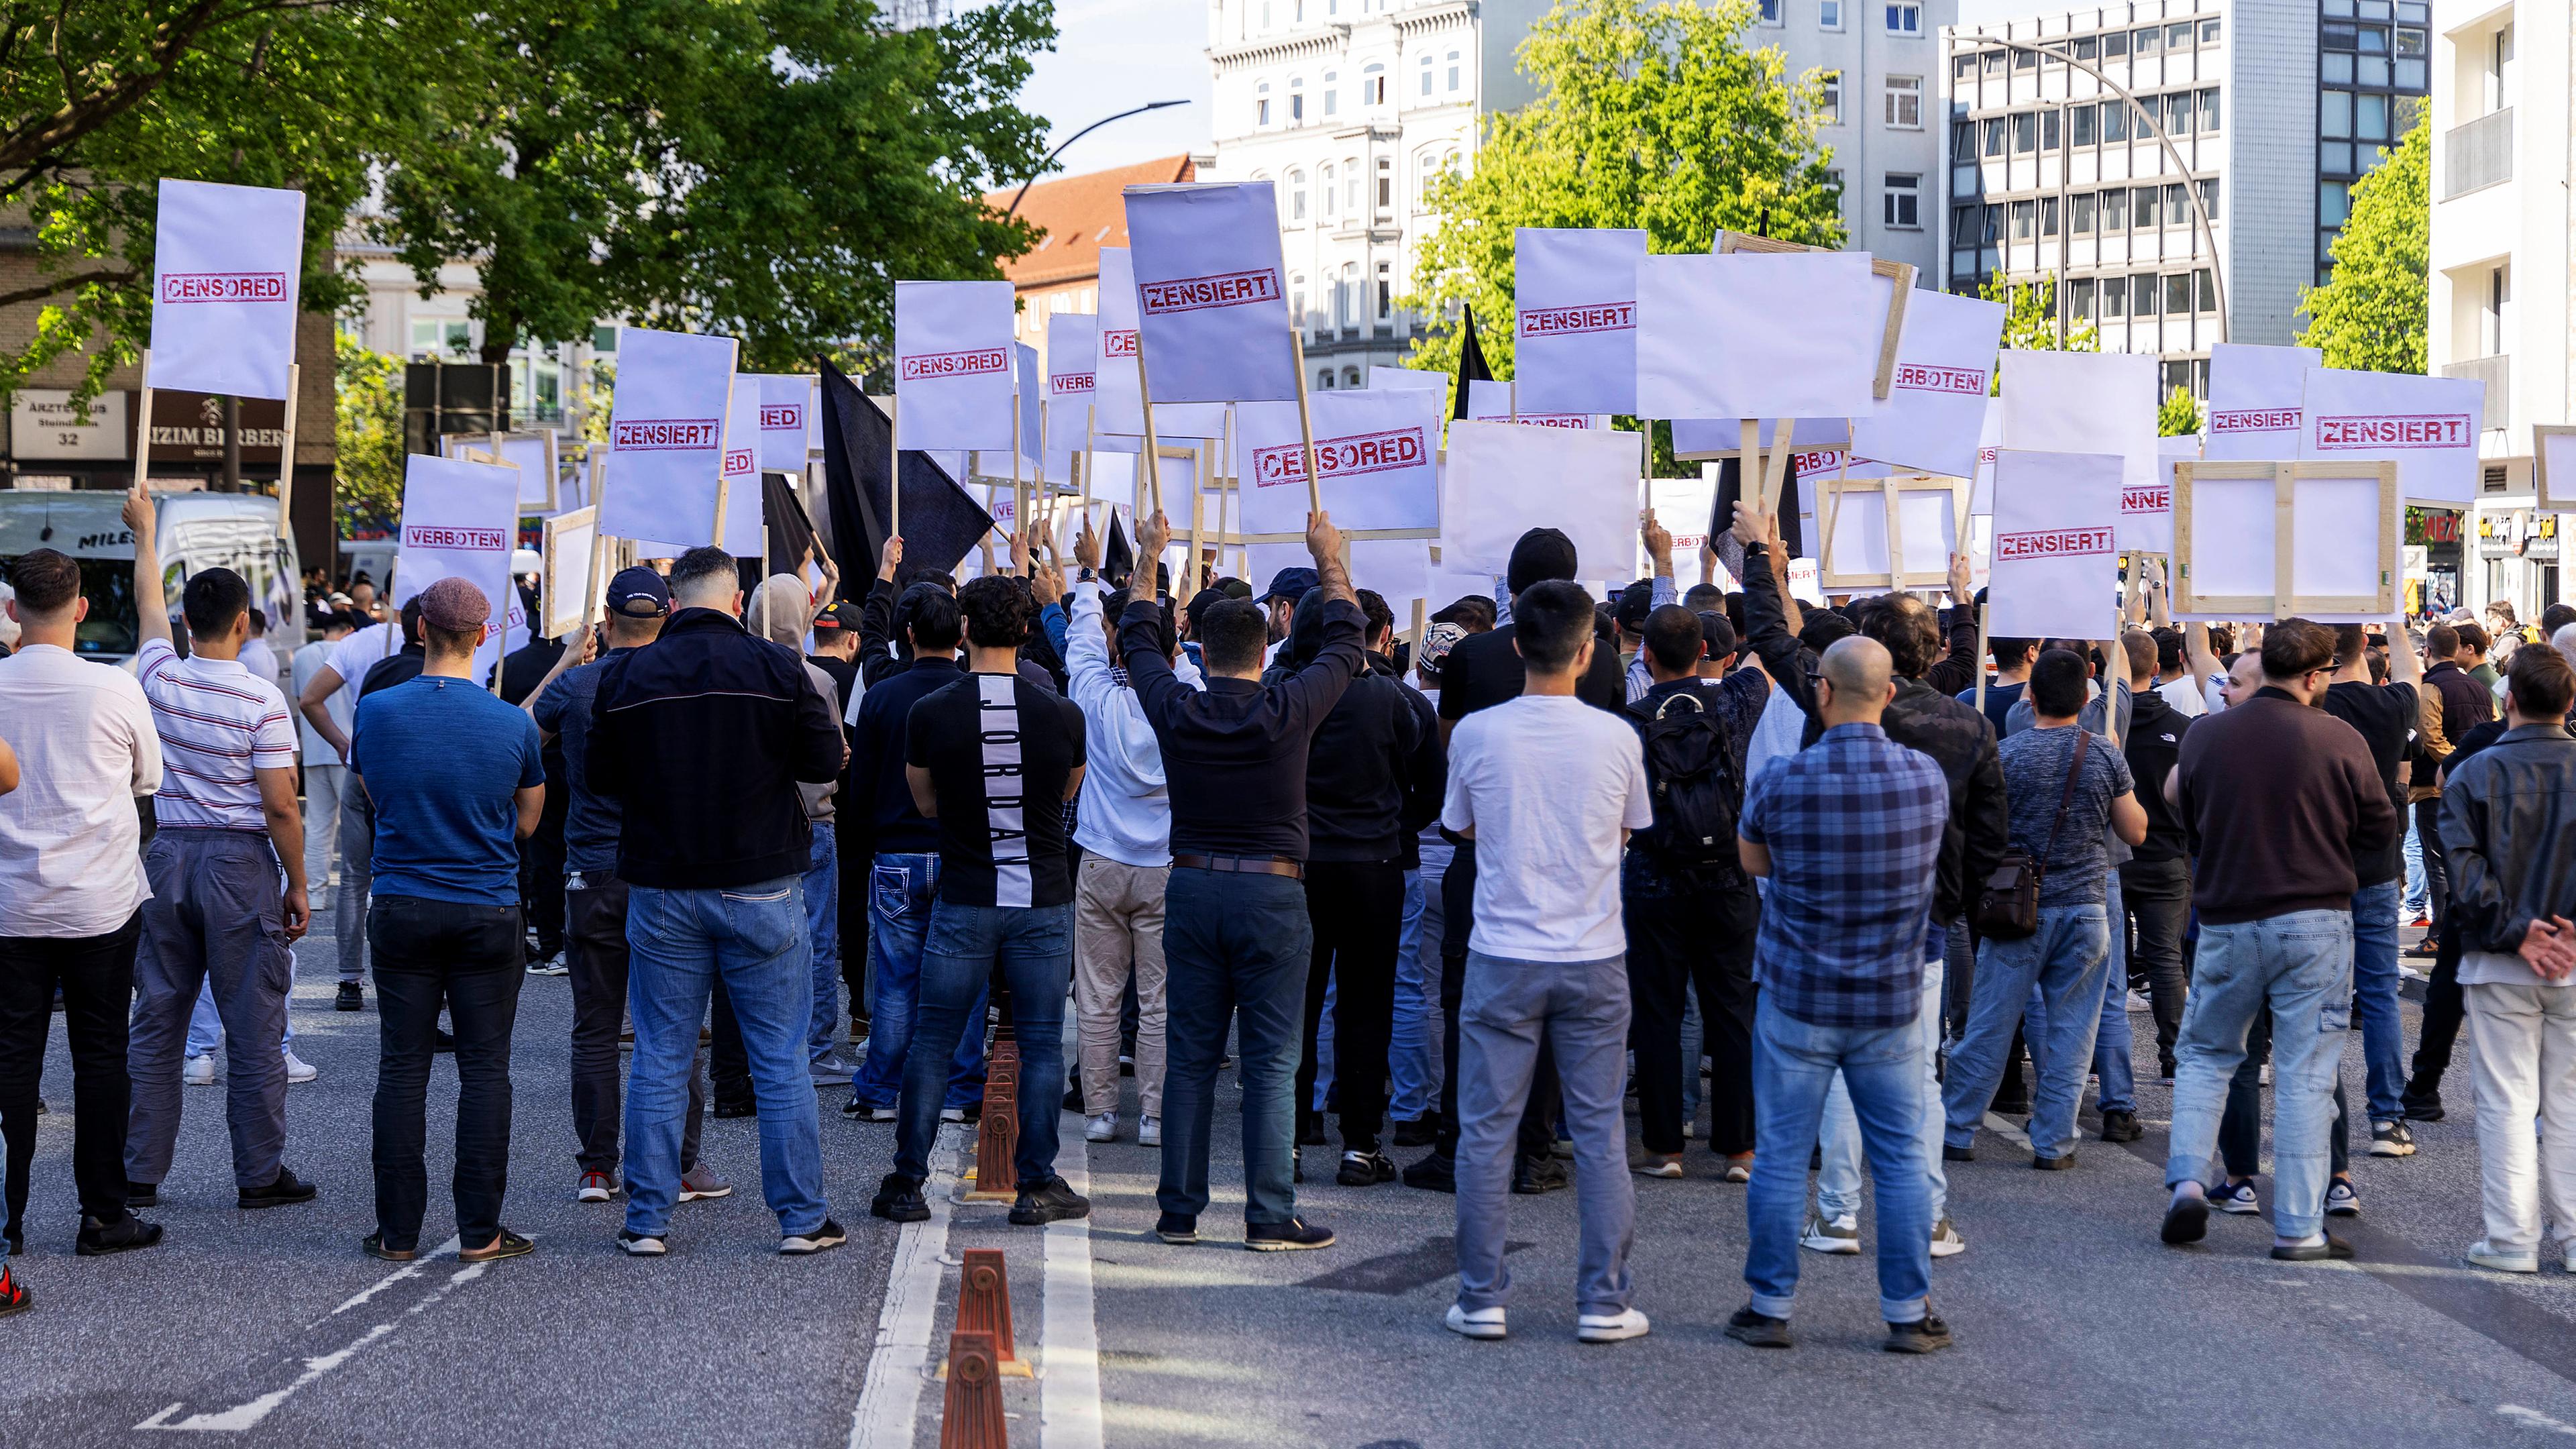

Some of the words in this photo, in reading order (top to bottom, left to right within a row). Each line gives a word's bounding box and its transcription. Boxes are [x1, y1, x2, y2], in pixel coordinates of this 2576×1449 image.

[168, 278, 280, 297] CENSORED
[1147, 276, 1268, 308] ZENSIERT
[1525, 307, 1631, 332] ZENSIERT
[907, 353, 1003, 375] CENSORED
[58, 432, 78, 445] 32
[619, 425, 713, 445] ZENSIERT
[2323, 421, 2462, 443] ZENSIERT
[411, 529, 500, 547] VERBOTEN
[2002, 532, 2108, 555] ZENSIERT
[977, 698, 1030, 866] JORDAN
